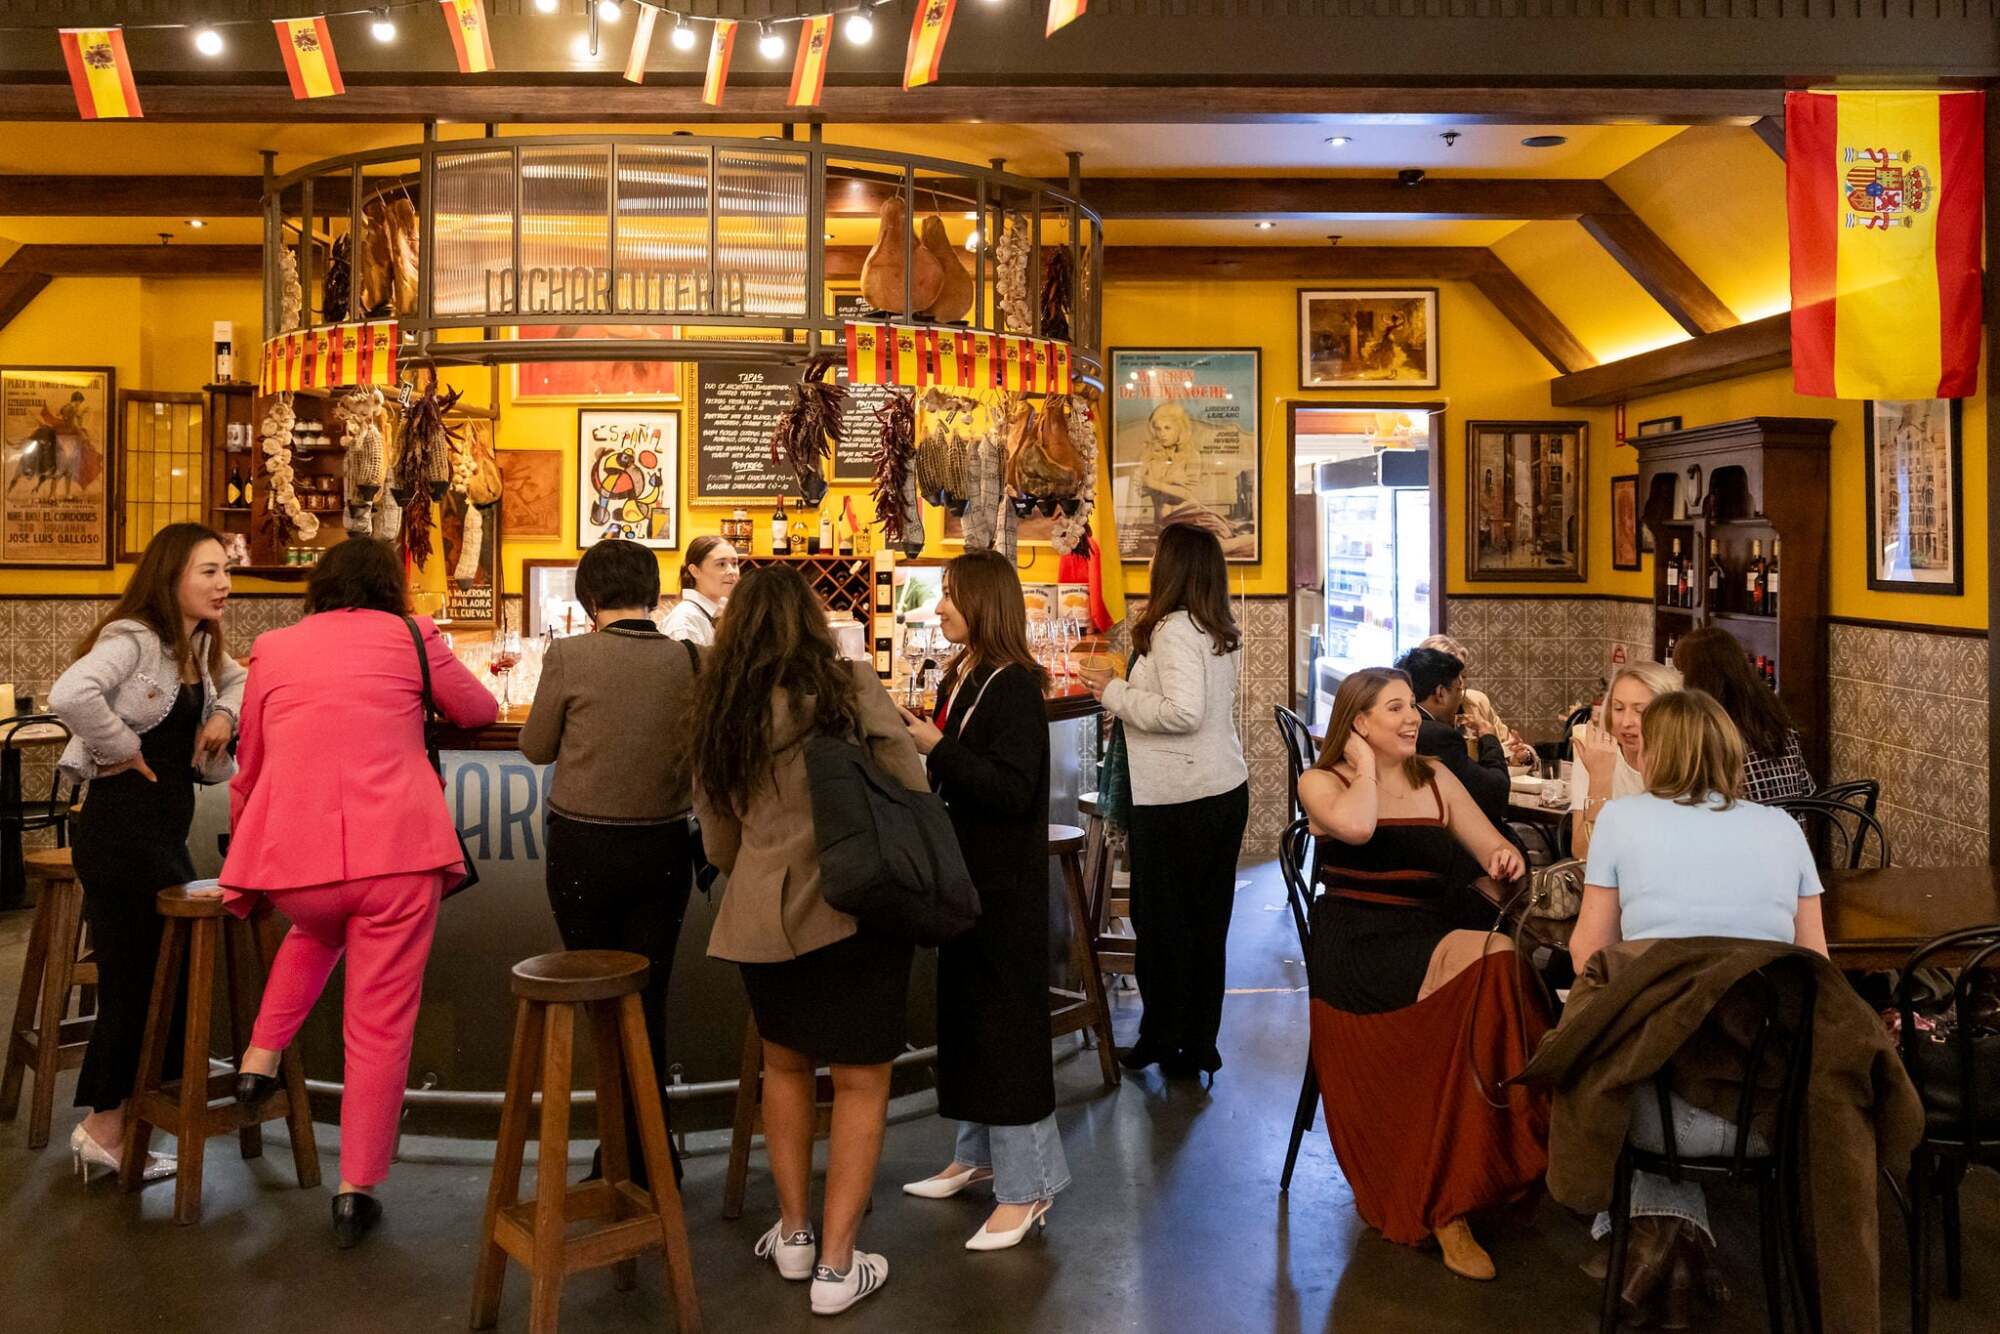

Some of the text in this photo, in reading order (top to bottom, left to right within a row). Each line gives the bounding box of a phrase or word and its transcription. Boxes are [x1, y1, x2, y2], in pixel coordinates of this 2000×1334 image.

[485, 268, 516, 315] LA
[738, 373, 764, 381] TAPAS
[592, 424, 663, 454] ESPAÑA
[33, 533, 54, 544] LUIS
[451, 599, 492, 608] BAILAORA
[460, 608, 493, 618] CUEVAS
